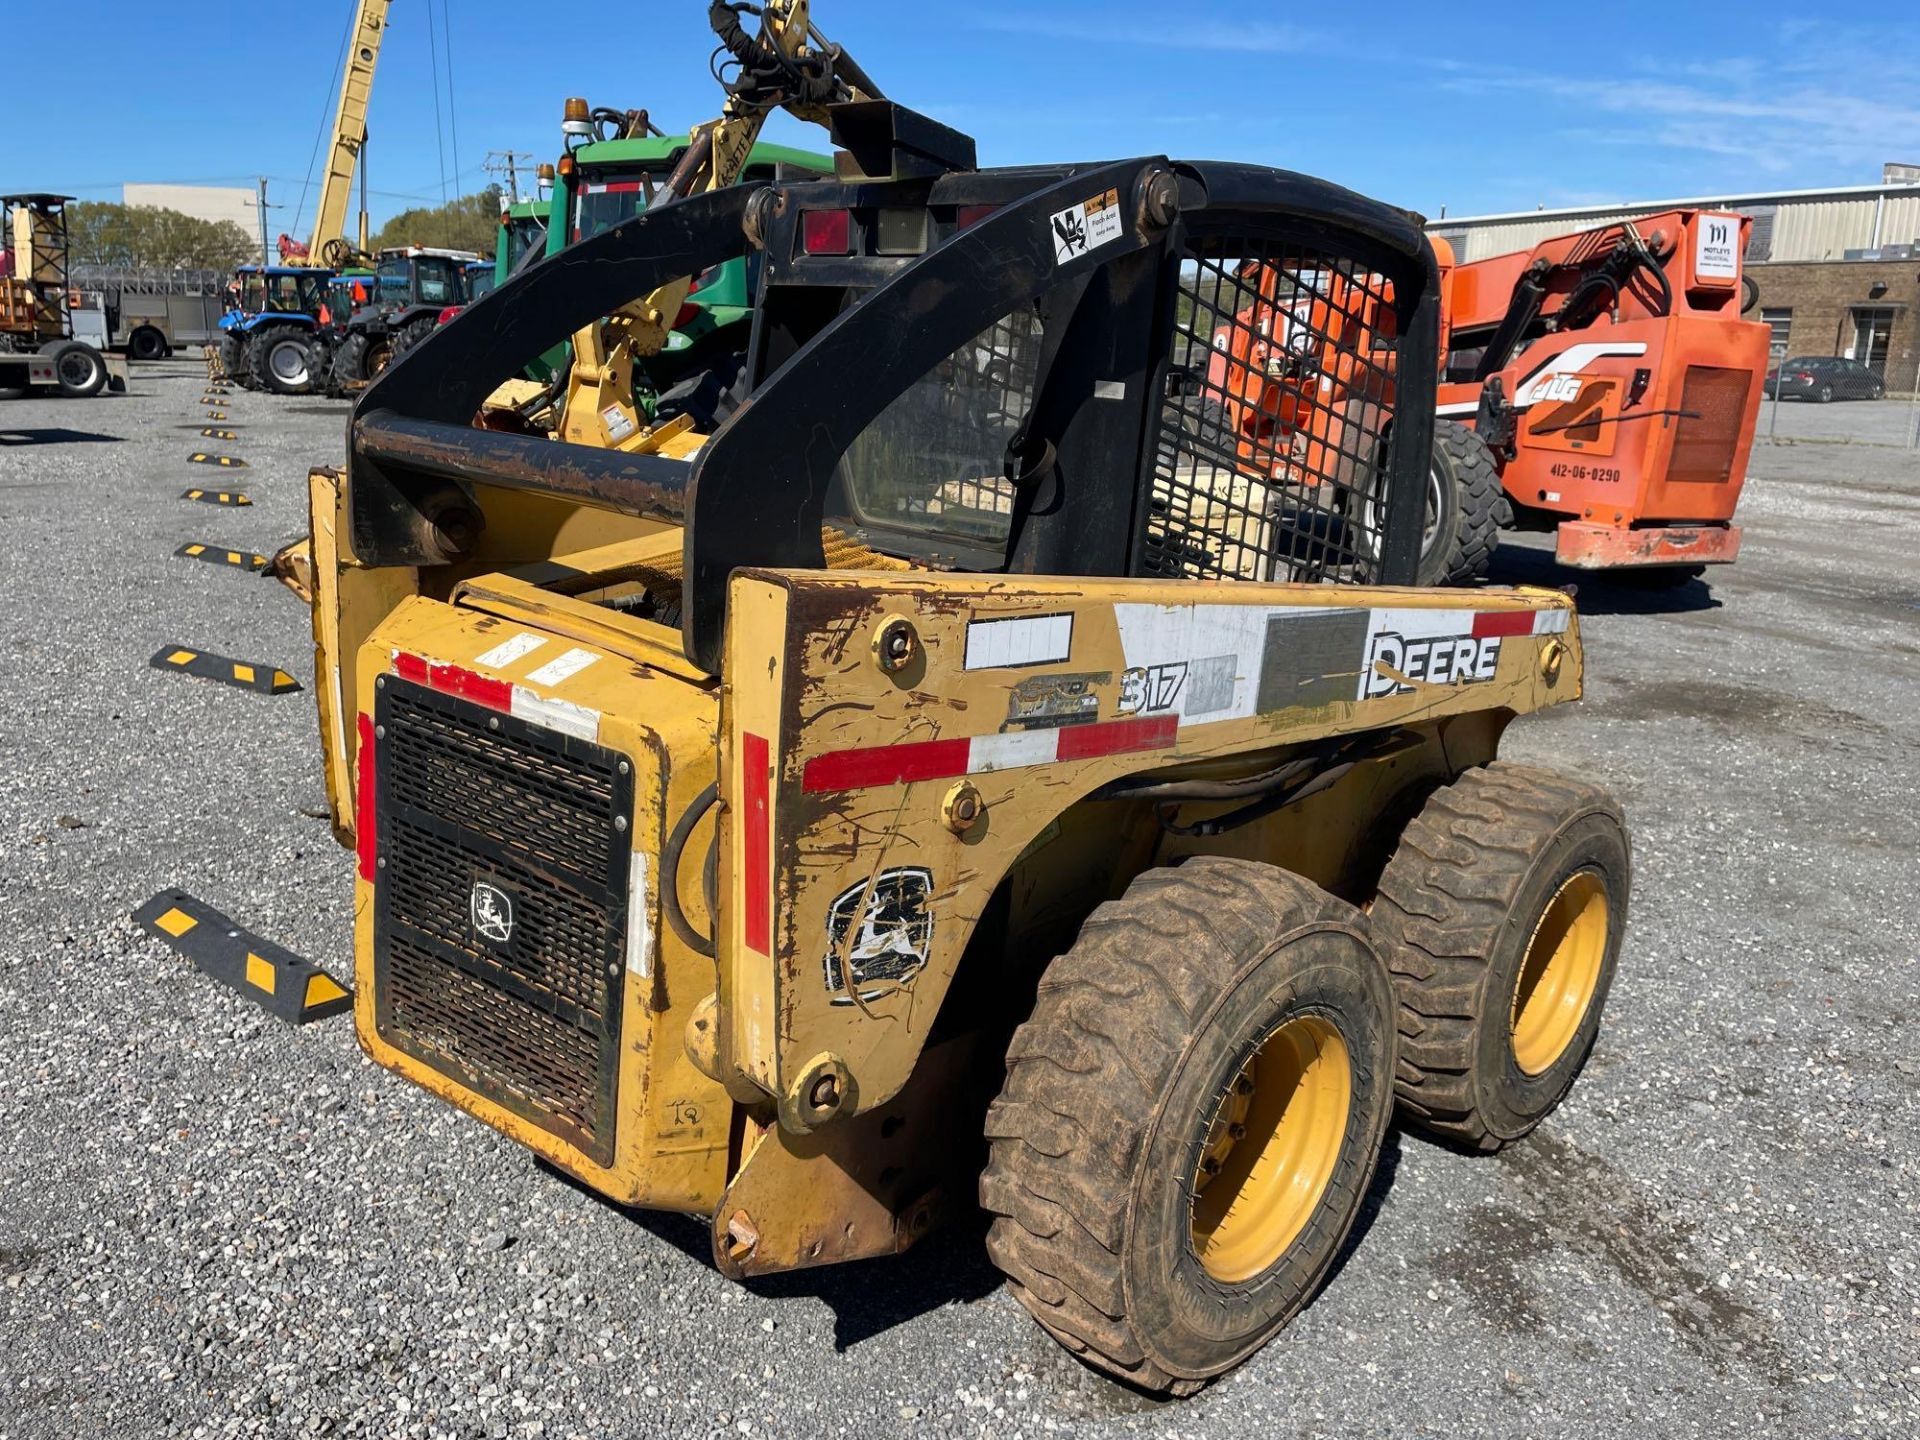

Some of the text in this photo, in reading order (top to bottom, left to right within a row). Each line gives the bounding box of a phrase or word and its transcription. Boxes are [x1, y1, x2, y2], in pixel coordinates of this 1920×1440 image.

[1704, 247, 1730, 255] MOTLEYS
[1531, 377, 1583, 402] JLG
[1550, 463, 1620, 482] 412-06-0290
[1365, 632, 1502, 697] DEERE
[1118, 661, 1189, 713] 317
